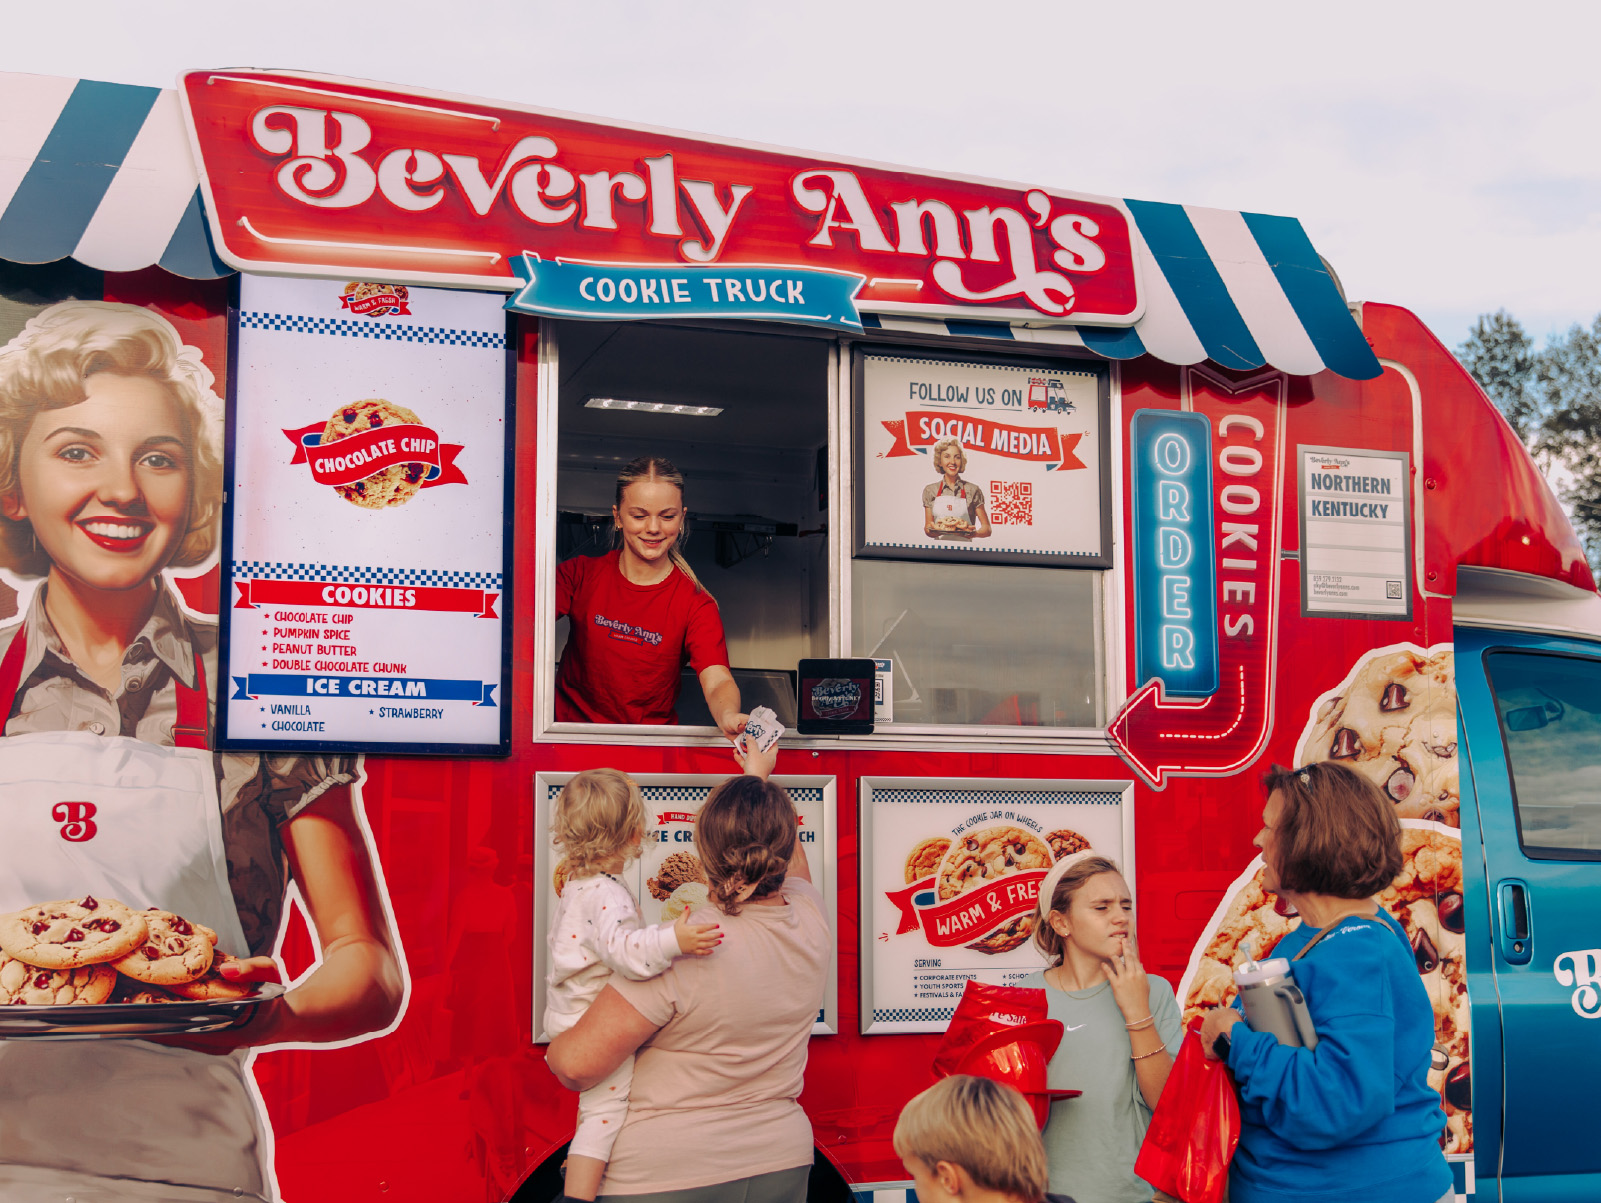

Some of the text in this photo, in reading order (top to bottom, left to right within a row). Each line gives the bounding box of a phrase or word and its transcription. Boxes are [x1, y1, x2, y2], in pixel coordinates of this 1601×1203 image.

[250, 105, 1106, 315] Beverly Ann's
[579, 277, 806, 304] COOKIE TRUCK
[909, 382, 1023, 406] FOLLOW US ON
[919, 417, 1053, 456] SOCIAL MEDIA
[314, 437, 436, 474] CHOCOLATE CHIP
[1311, 473, 1391, 495] NORTHERN
[1311, 500, 1389, 519] KENTUCKY
[1218, 414, 1265, 638] COOKIES
[1154, 432, 1195, 670] ORDER
[321, 586, 416, 607] COOKIES
[274, 611, 354, 625] CHOCOLATE CHIP
[595, 614, 633, 634] Beverly
[273, 628, 351, 641] PUMPKIN SPICE
[272, 643, 357, 657] PEANUT BUTTER
[272, 659, 408, 674] DOUBLE CHOCOLATE CHUNK
[306, 678, 427, 697] ICE CREAM
[270, 704, 311, 716] VANILLA
[379, 707, 444, 720] STRAWBERRY
[271, 721, 326, 733] CHOCOLATE
[51, 801, 98, 843] B
[670, 813, 686, 821] HAND
[951, 810, 1043, 836] THE COOKIE JAR ON WHEELS
[936, 903, 986, 936] WARM
[986, 891, 1003, 913] &
[914, 959, 942, 968] SERVING
